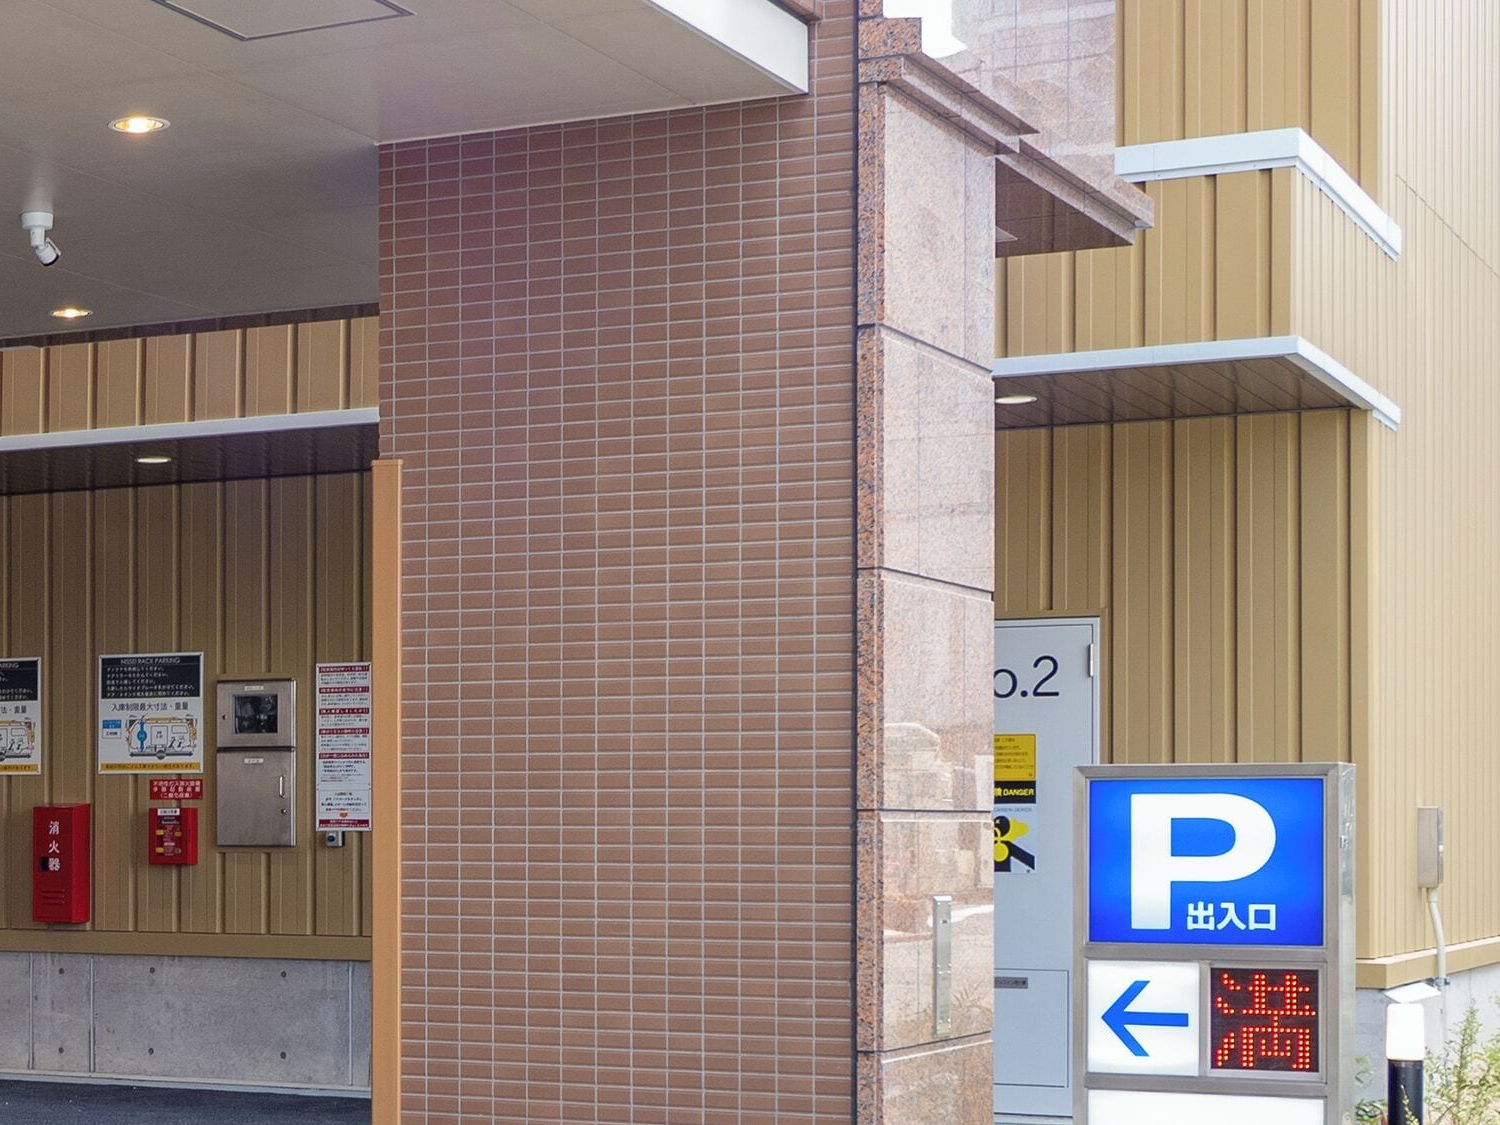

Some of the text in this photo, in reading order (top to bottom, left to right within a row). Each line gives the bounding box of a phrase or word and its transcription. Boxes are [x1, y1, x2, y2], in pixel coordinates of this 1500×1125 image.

[994, 655, 1060, 699] o.2
[1004, 788, 1034, 796] DANGER
[48, 820, 61, 872] 消火器
[1130, 792, 1278, 930] P
[1186, 902, 1278, 931] 出入口
[1216, 973, 1317, 1070] 満
